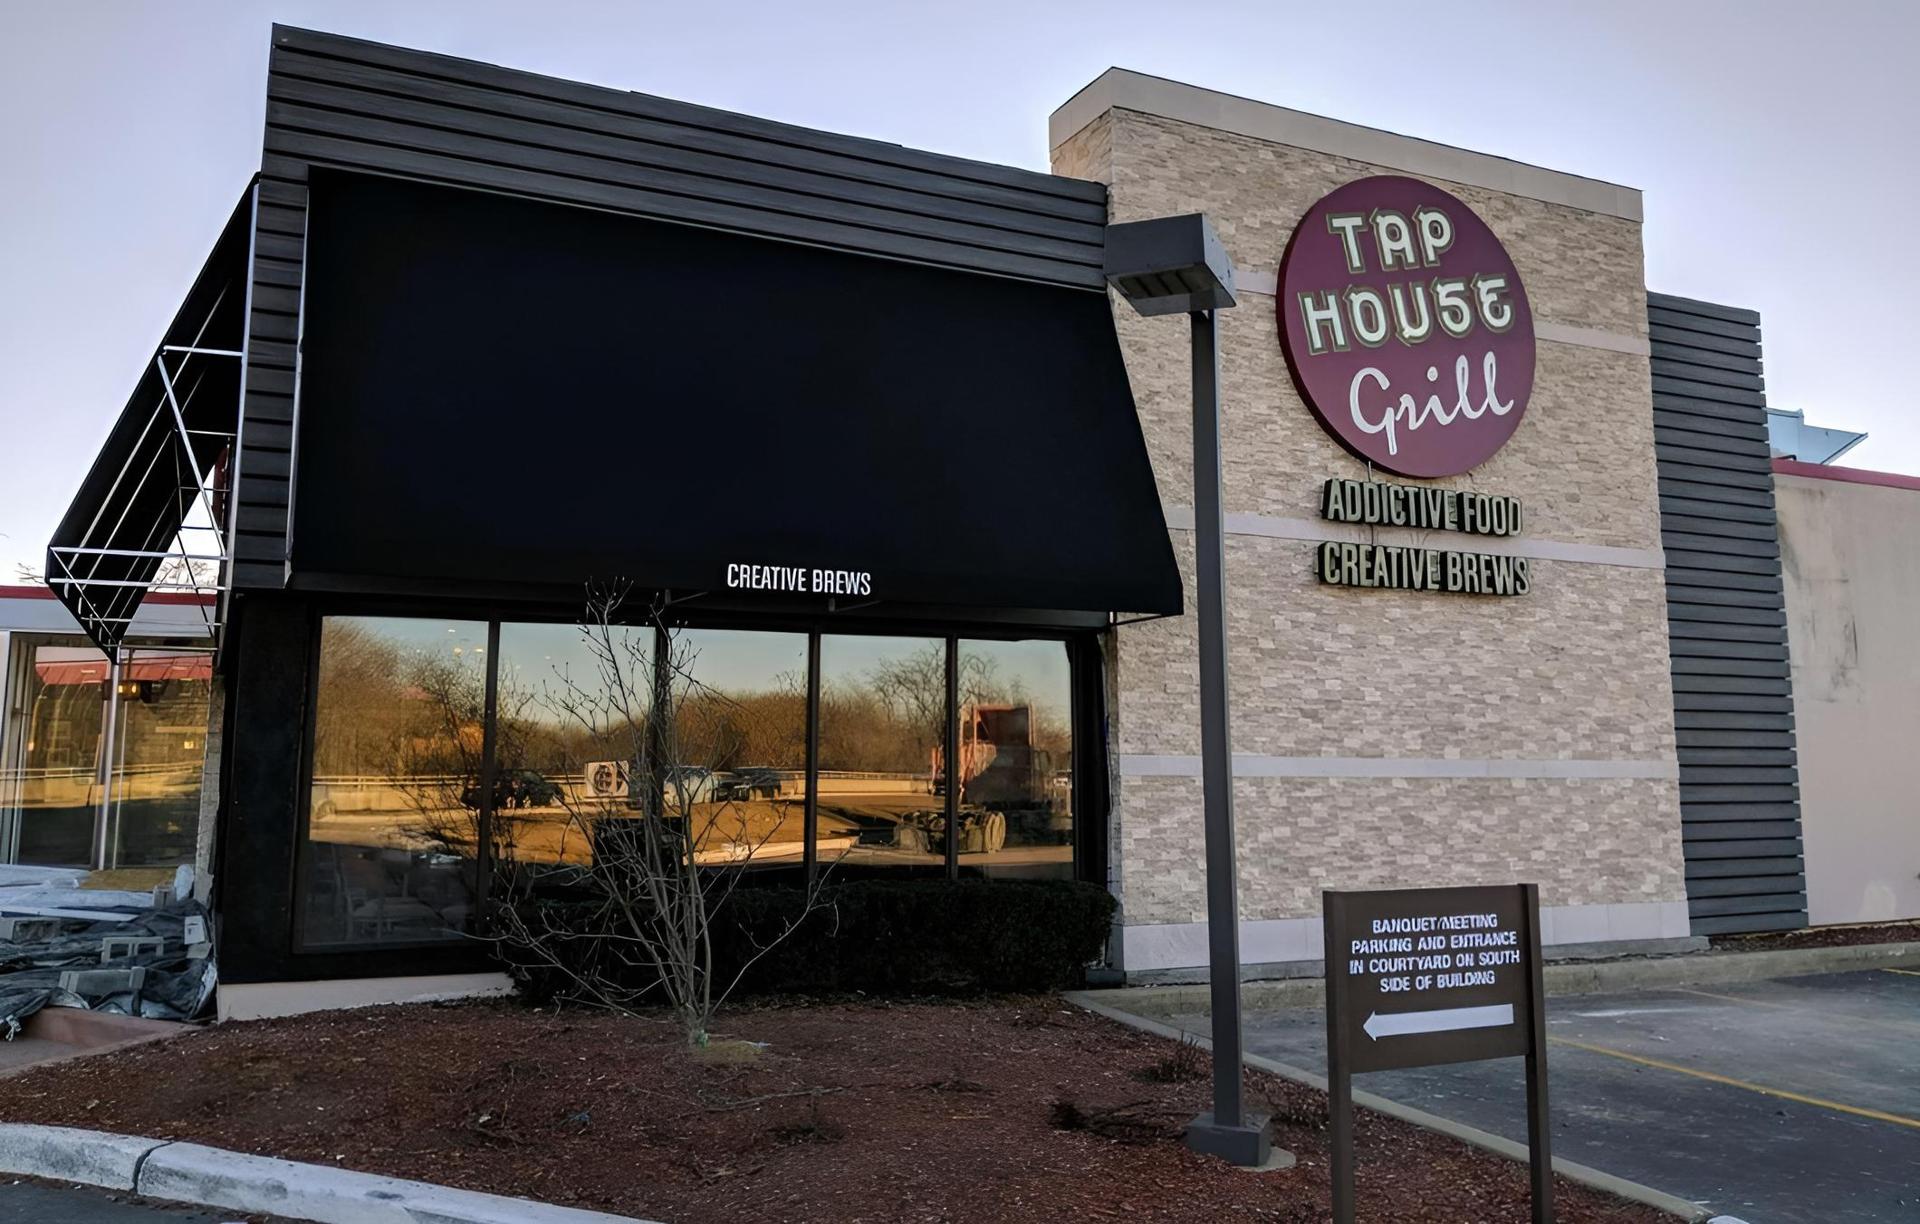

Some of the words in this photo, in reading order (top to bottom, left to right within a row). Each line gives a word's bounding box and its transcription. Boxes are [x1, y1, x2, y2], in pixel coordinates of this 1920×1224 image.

[1327, 205, 1454, 273] TAP
[1299, 274, 1515, 355] HOUSE
[1349, 351, 1514, 456] Grill
[1322, 479, 1459, 530] ADDICTIVE
[1463, 492, 1522, 536] FOOD
[727, 563, 807, 592] CREATIVE
[812, 569, 871, 596] BREWS
[1318, 541, 1440, 590] CREATIVE
[1441, 551, 1531, 596] BREWS
[1349, 959, 1364, 974] IN
[1369, 954, 1451, 973] COURTYARD
[1456, 953, 1474, 967] ON
[1479, 949, 1521, 966] SOUTH
[1351, 937, 1412, 954] PARKING
[1417, 935, 1446, 950] AND
[1450, 931, 1517, 949] ENTRANCE
[1380, 976, 1411, 993] SIDE
[1415, 975, 1432, 990] OF
[1437, 970, 1496, 989] BUILDING
